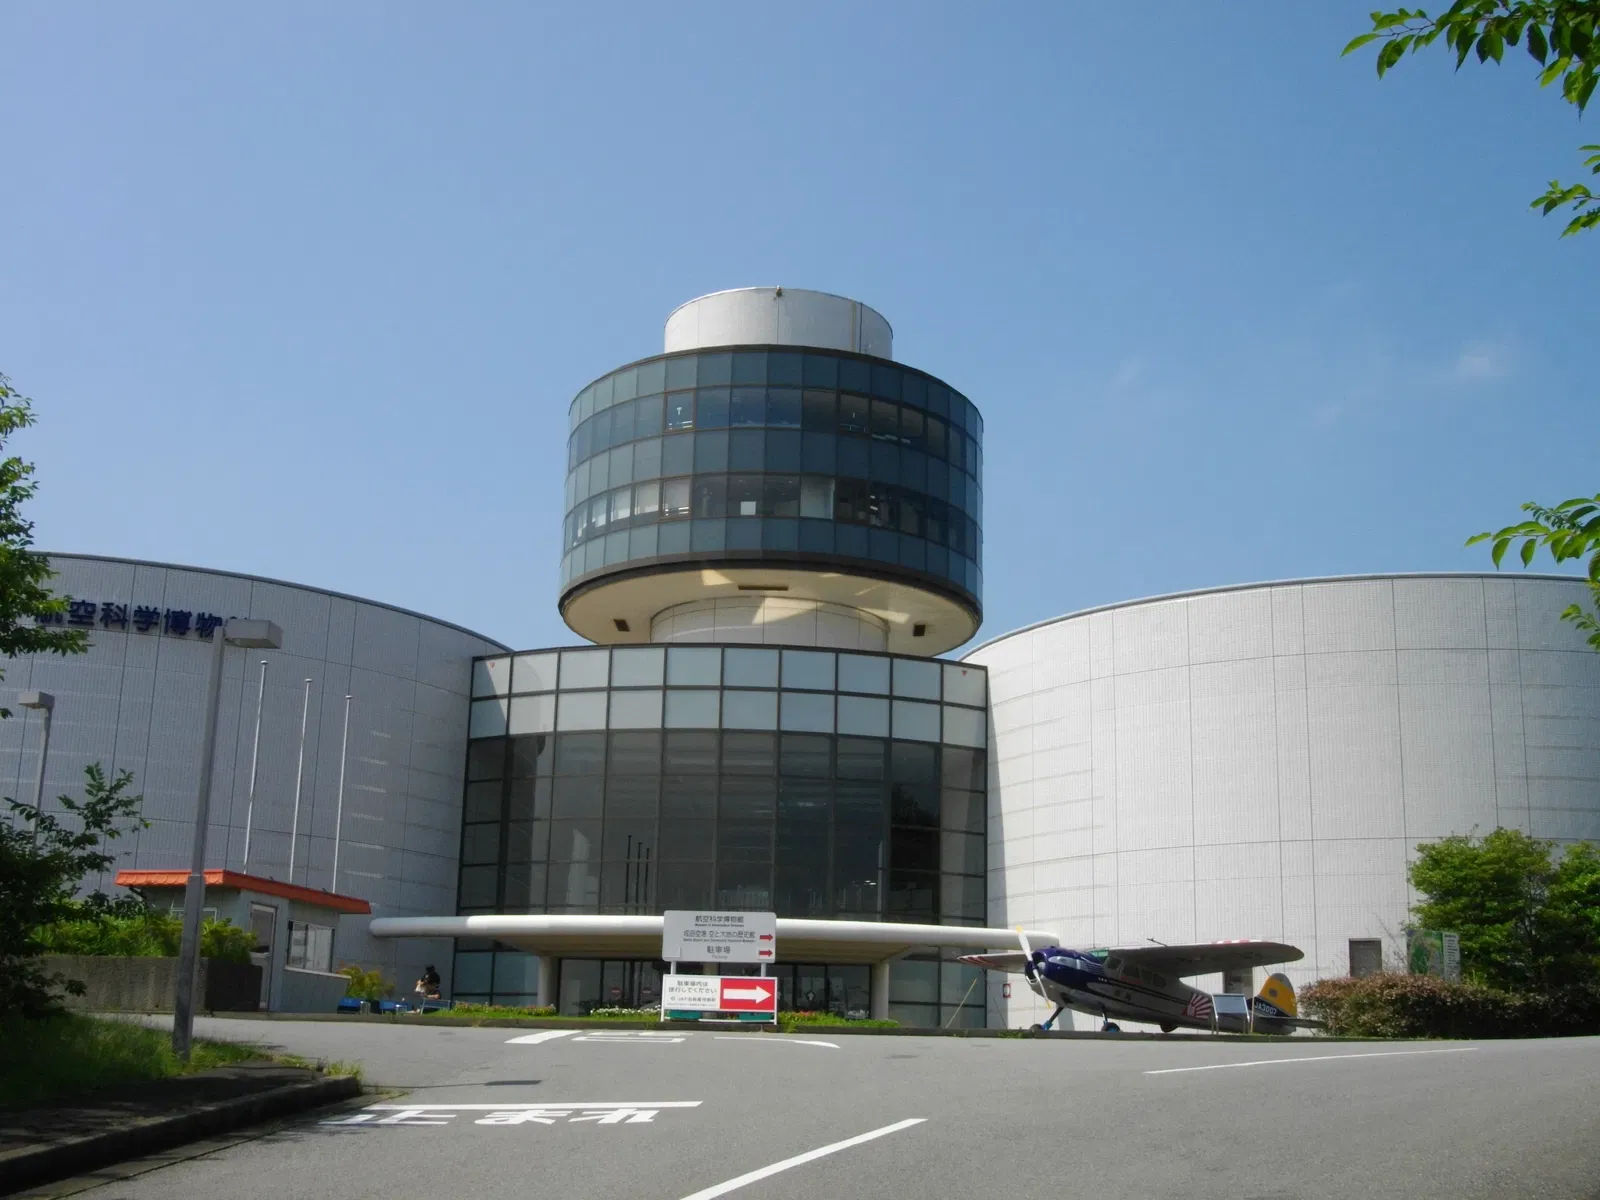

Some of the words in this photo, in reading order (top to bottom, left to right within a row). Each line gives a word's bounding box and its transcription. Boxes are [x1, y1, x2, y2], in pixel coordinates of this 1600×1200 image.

[34, 600, 248, 638] 空科学博物
[706, 945, 731, 954] 駐車場
[317, 1108, 659, 1125] 止まれ
